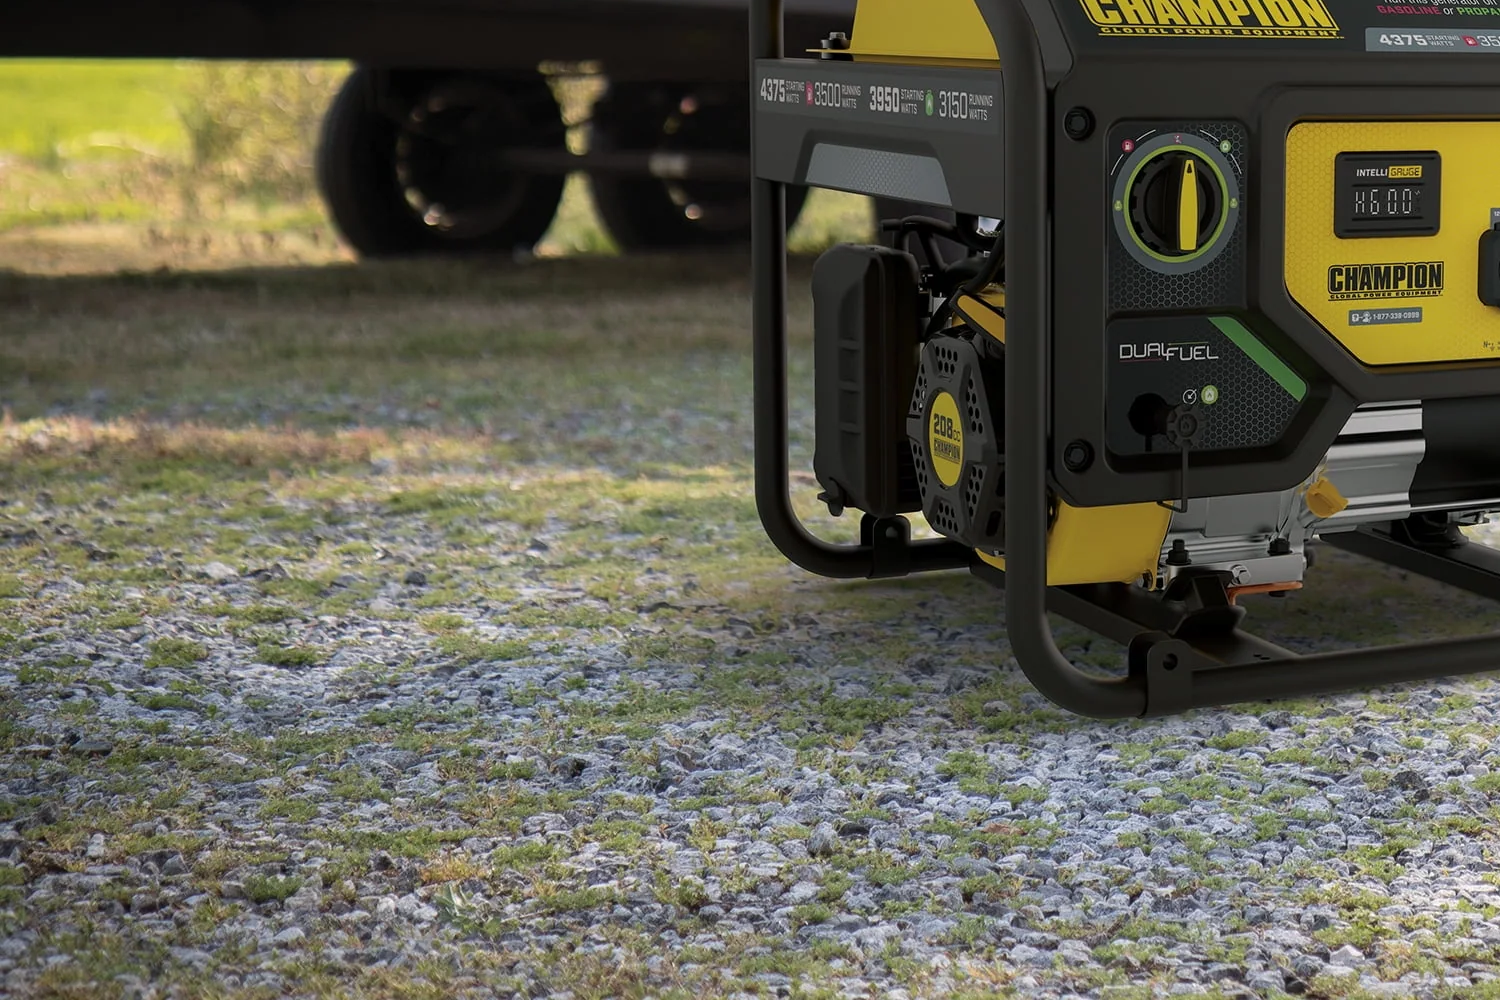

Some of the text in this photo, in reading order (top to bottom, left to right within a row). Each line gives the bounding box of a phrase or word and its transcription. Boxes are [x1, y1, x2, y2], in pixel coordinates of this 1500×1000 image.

[1376, 5, 1442, 15] GASOLINE
[1443, 7, 1455, 16] or
[1100, 27, 1340, 37] GLOBAL POWER EQUIPMENT
[1379, 33, 1460, 46] 4375 STARTING
[760, 77, 805, 102] 4375 STARTING
[814, 81, 862, 107] 3500 RUNNING
[786, 92, 800, 104] WATTS
[842, 97, 857, 109] WATTS
[869, 85, 925, 113] 3950 STARTING
[901, 102, 918, 115] WATTS
[939, 90, 994, 120] 3150 RUNNING
[969, 108, 988, 121] WATTS
[1328, 262, 1443, 293] CHAMPION
[933, 438, 960, 461] CHAMPION
